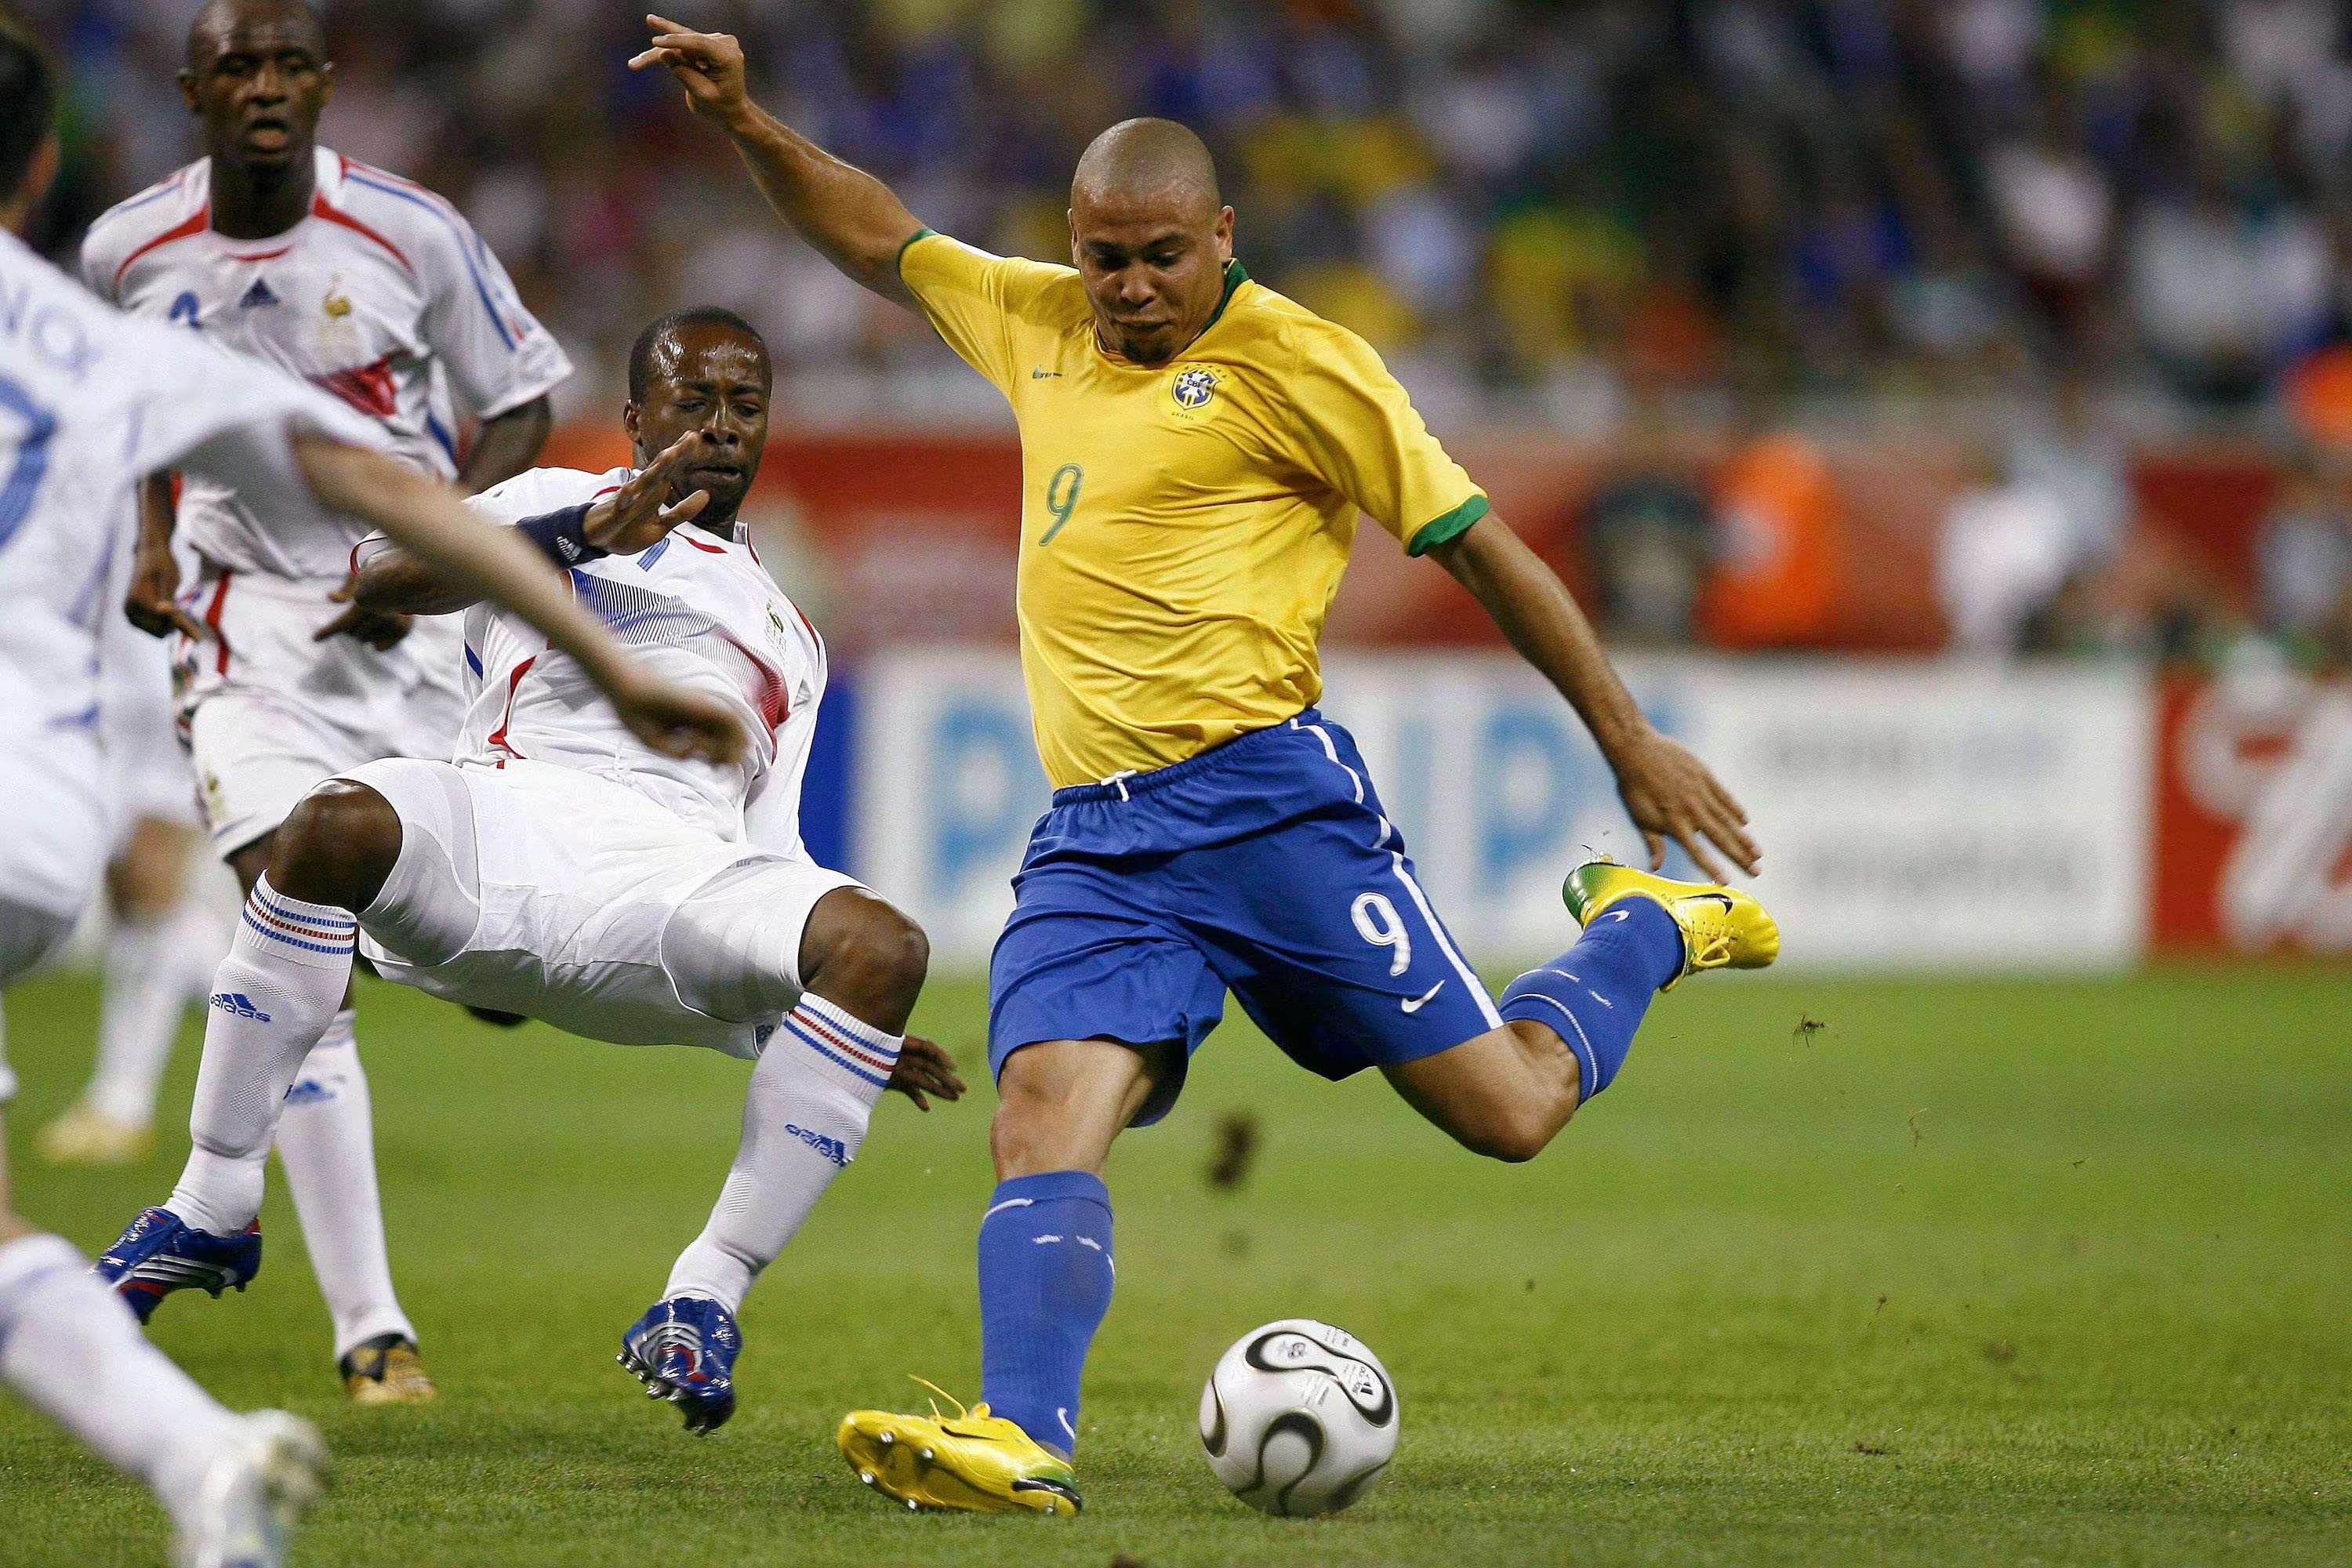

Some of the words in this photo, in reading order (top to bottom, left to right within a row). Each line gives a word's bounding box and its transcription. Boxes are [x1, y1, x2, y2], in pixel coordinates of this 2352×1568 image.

[1038, 463, 1084, 546] 9
[1350, 891, 1411, 976] 9
[209, 993, 271, 1022] adidas
